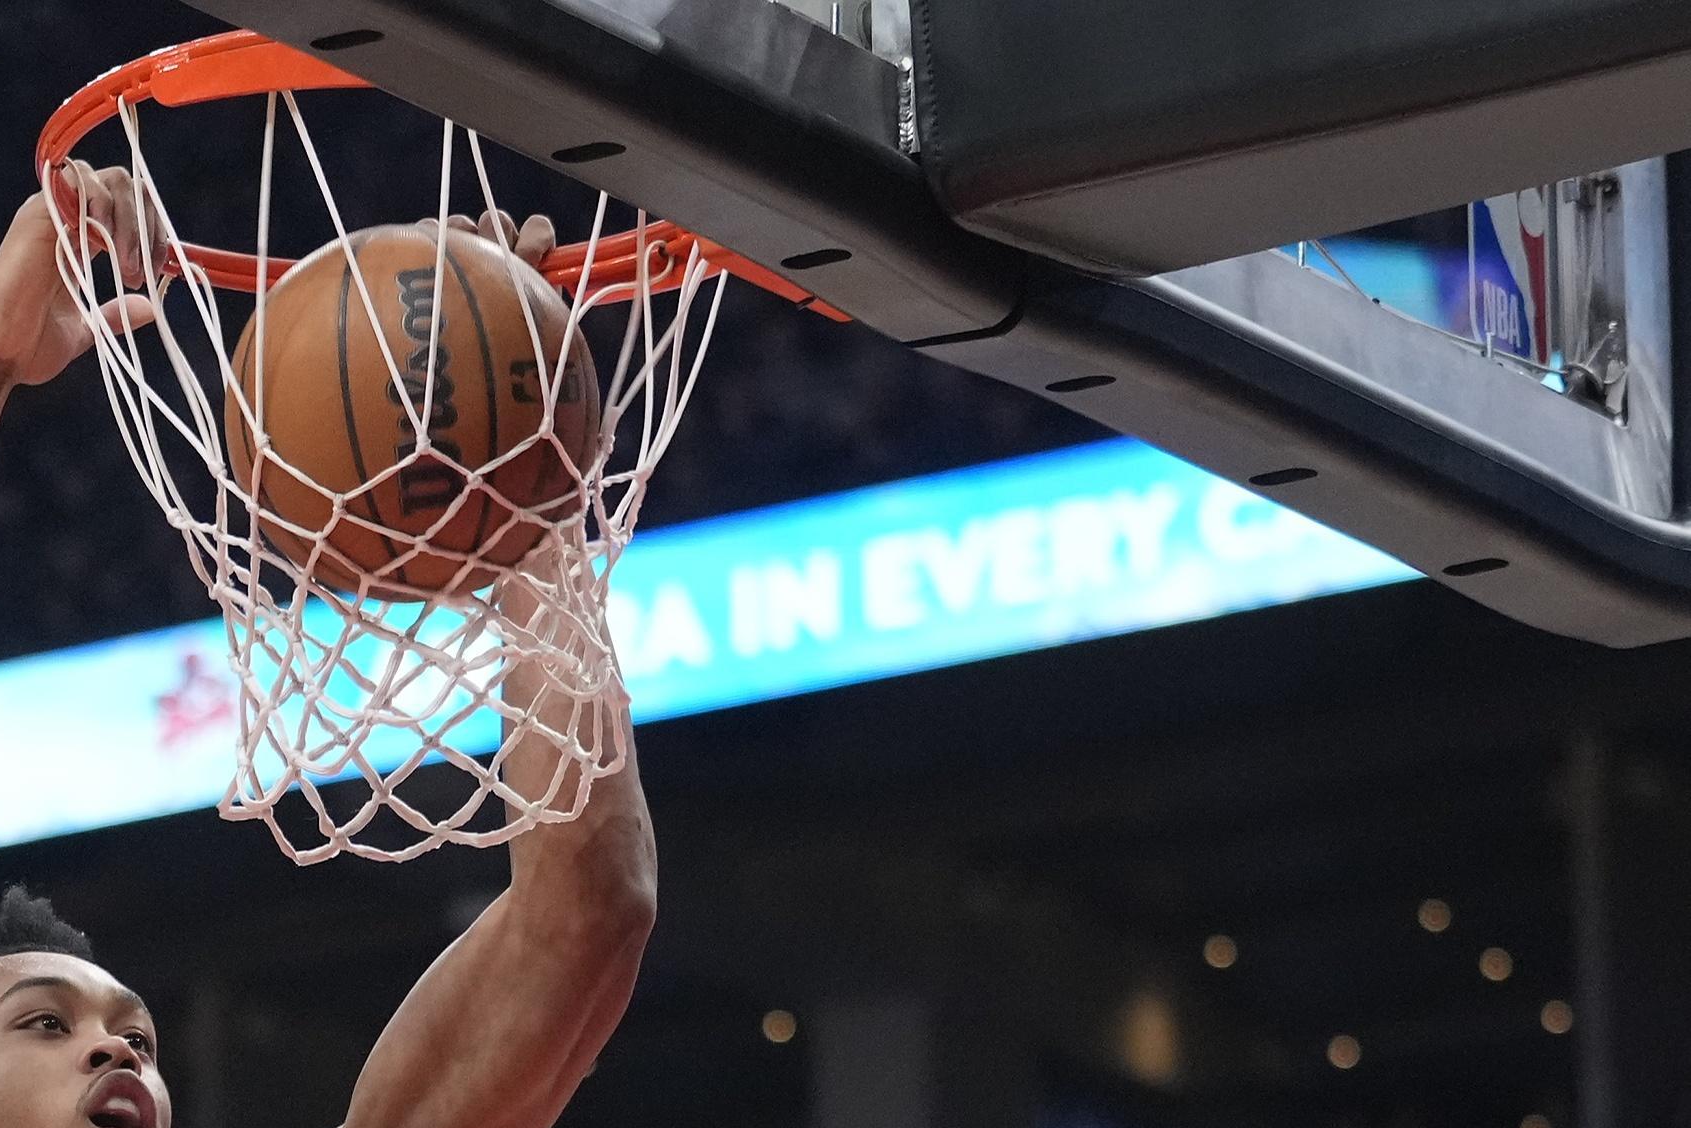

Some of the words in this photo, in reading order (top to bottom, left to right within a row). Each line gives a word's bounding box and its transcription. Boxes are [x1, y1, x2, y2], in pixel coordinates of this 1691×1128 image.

[386, 265, 468, 518] Wilson
[1482, 279, 1522, 349] NBA
[730, 543, 841, 656] IN
[862, 486, 1178, 630] EVERY
